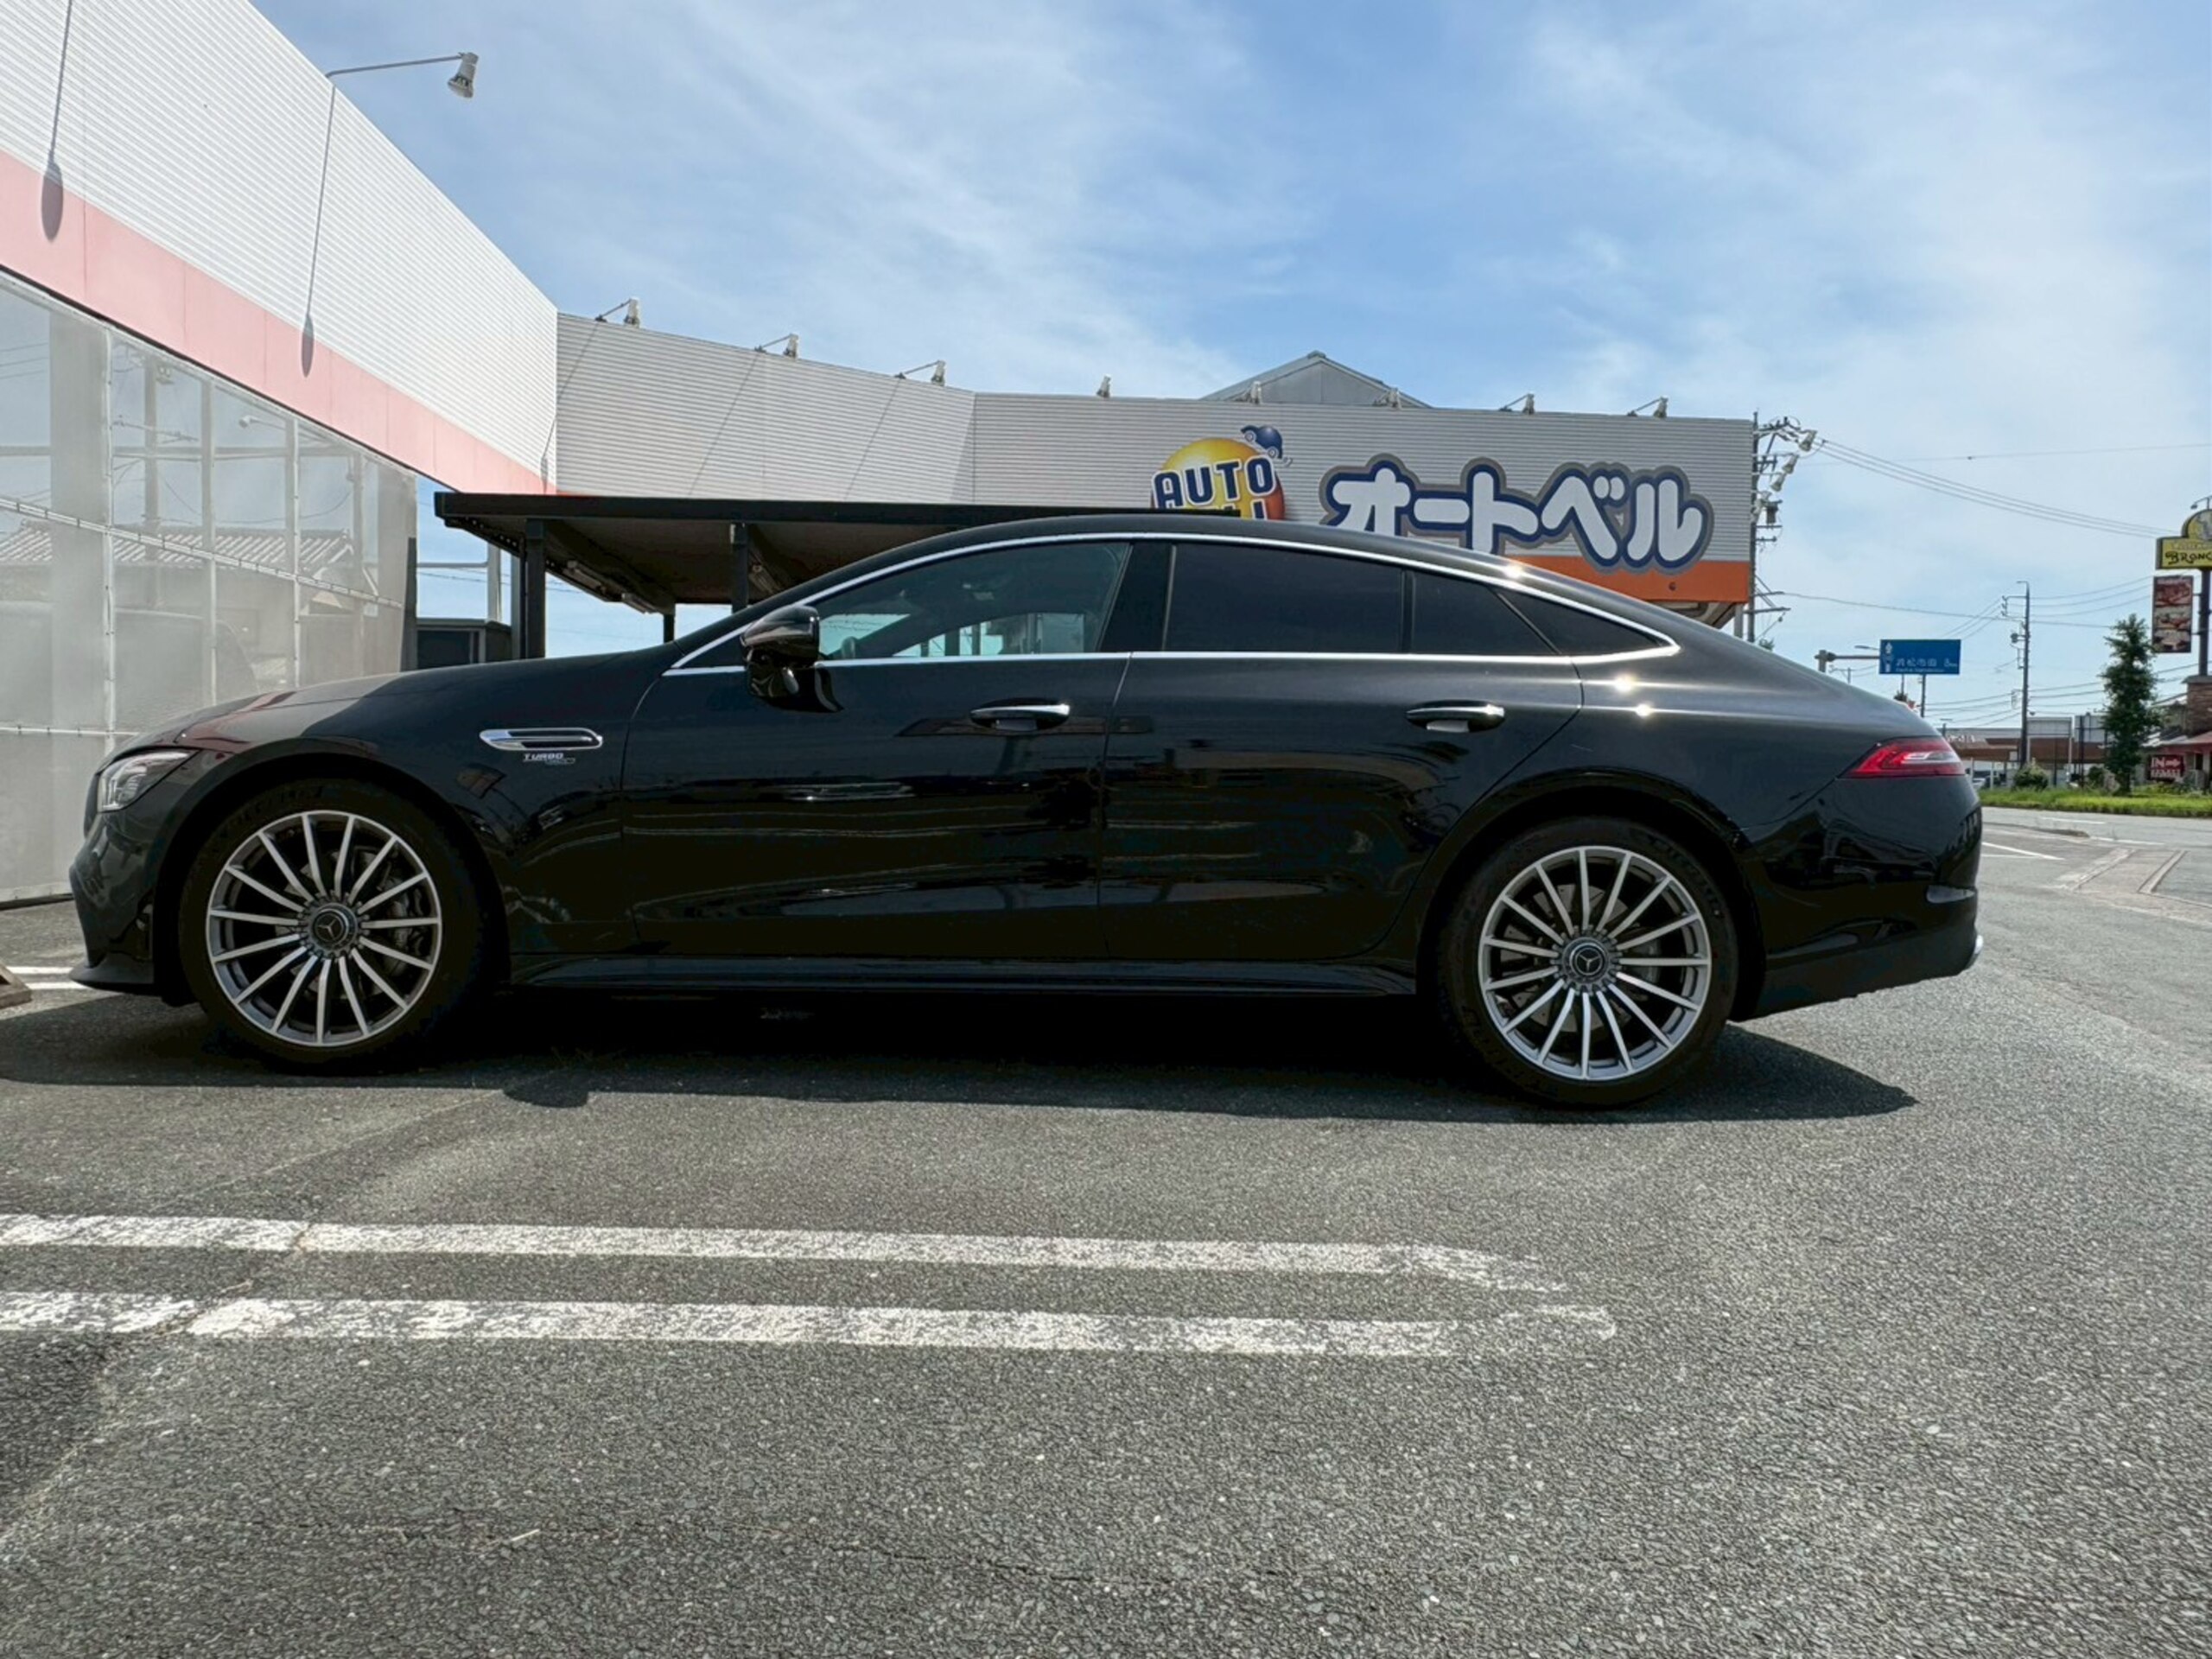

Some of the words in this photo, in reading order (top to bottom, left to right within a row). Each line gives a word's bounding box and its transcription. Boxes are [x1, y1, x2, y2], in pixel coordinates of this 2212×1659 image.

[1152, 455, 1275, 509] AUTO
[1326, 461, 1707, 568] オートベル
